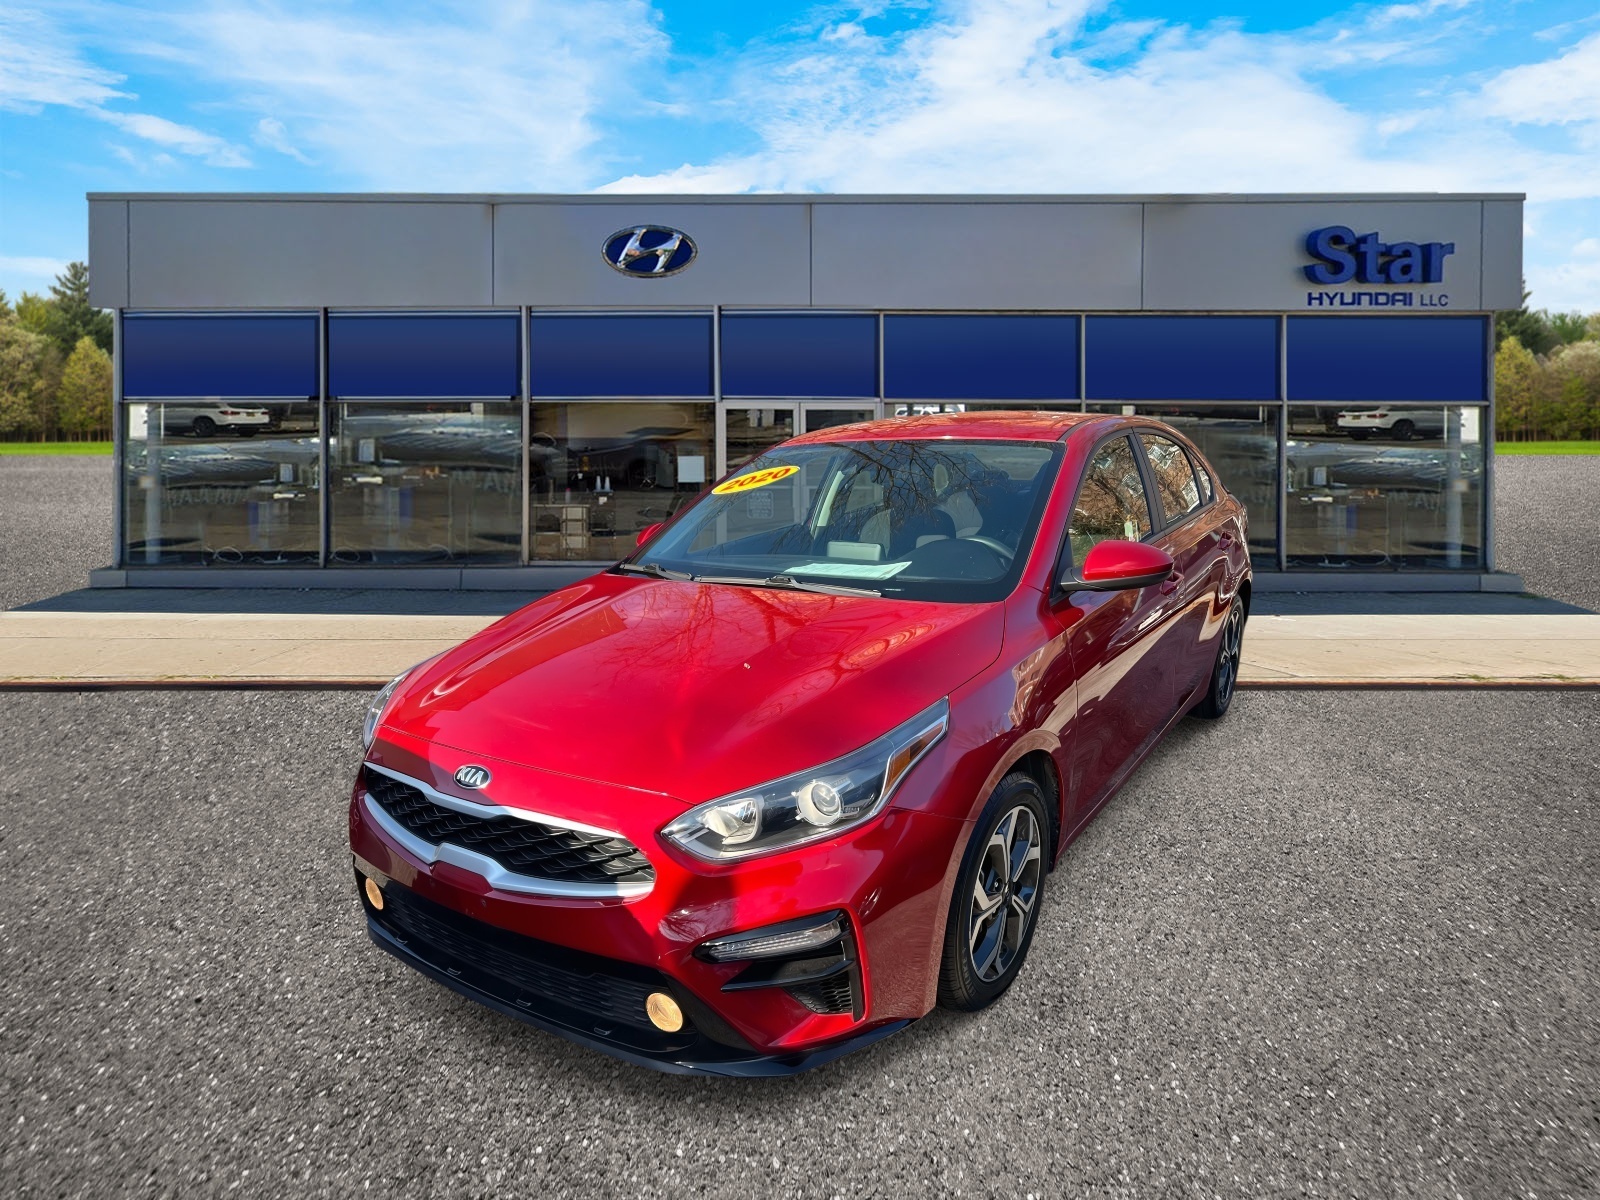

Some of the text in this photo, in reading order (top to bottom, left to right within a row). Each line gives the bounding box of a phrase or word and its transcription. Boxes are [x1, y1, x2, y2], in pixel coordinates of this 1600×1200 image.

[1303, 225, 1455, 284] Star
[1307, 292, 1449, 307] HYUNDAI LLC
[720, 468, 791, 492] 2020
[456, 766, 485, 786] KIA
